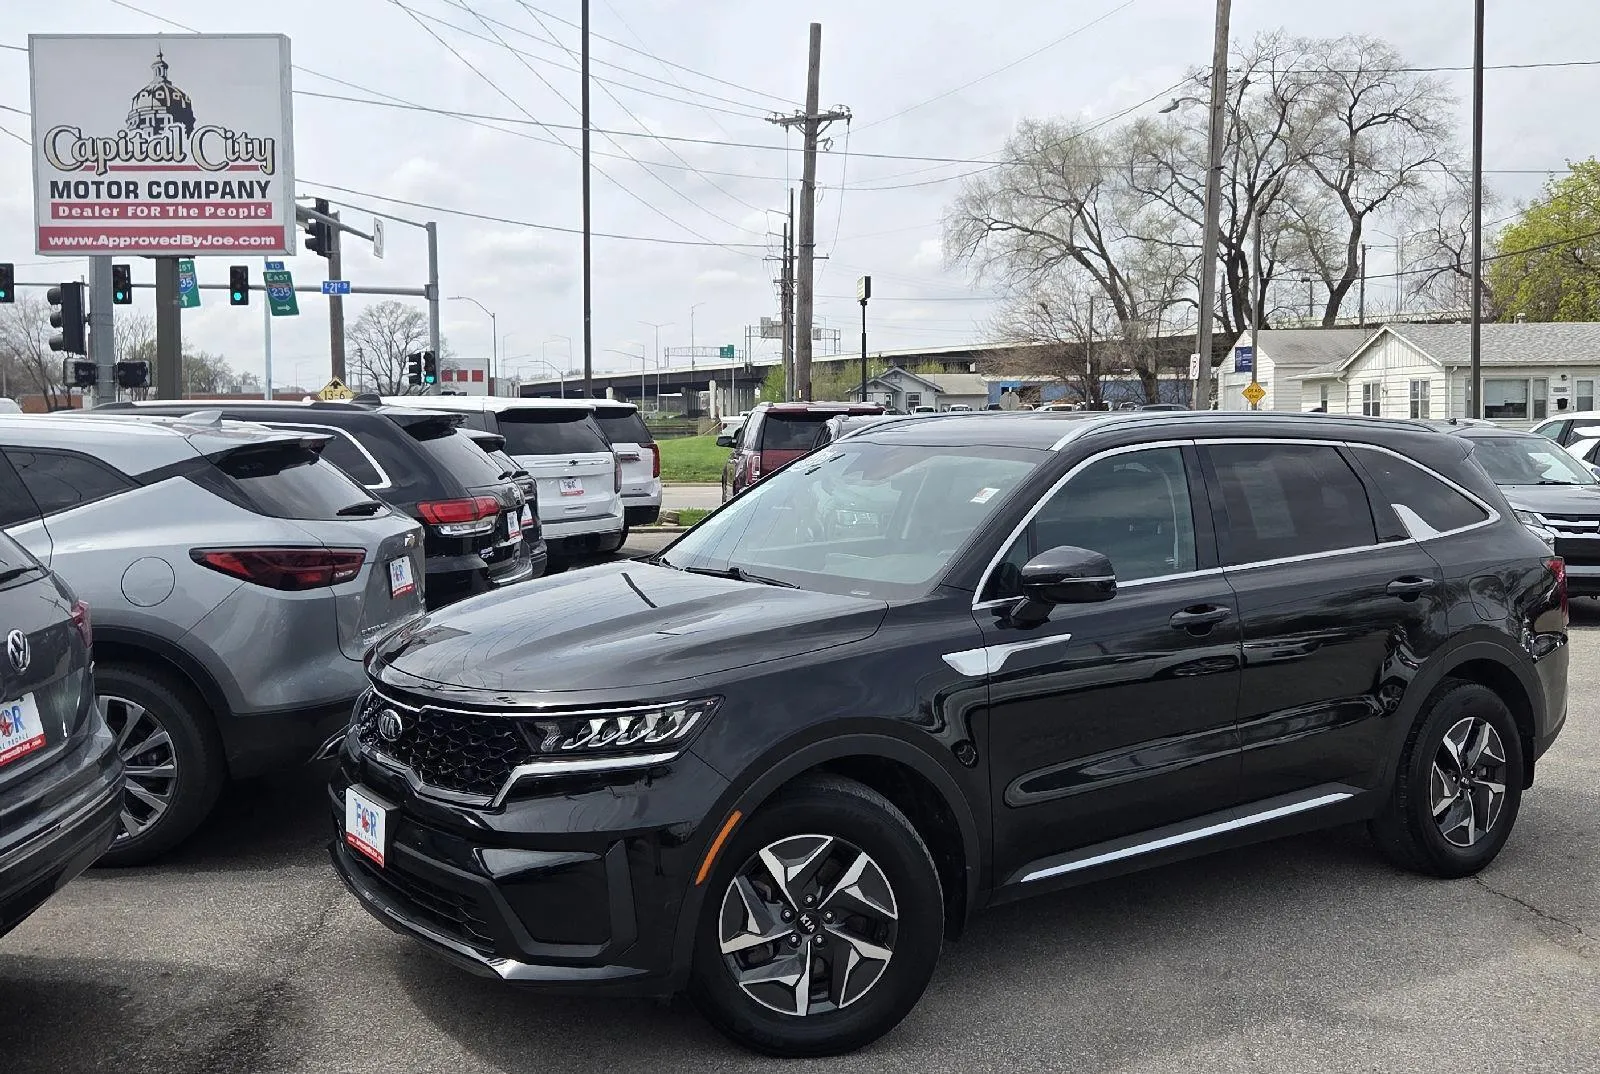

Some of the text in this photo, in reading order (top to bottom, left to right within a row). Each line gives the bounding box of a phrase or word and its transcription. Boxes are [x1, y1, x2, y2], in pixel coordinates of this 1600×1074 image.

[43, 125, 275, 175] Capital City
[50, 180, 271, 199] MOTOR COMPANY
[58, 205, 120, 217] Dealer
[127, 205, 161, 217] FOR
[166, 205, 198, 217] The
[48, 234, 275, 248] www.ApprovedByJoe.com
[179, 278, 194, 288] 35
[266, 273, 289, 281] EAST
[271, 287, 291, 297] 235
[799, 913, 816, 933] KIA
